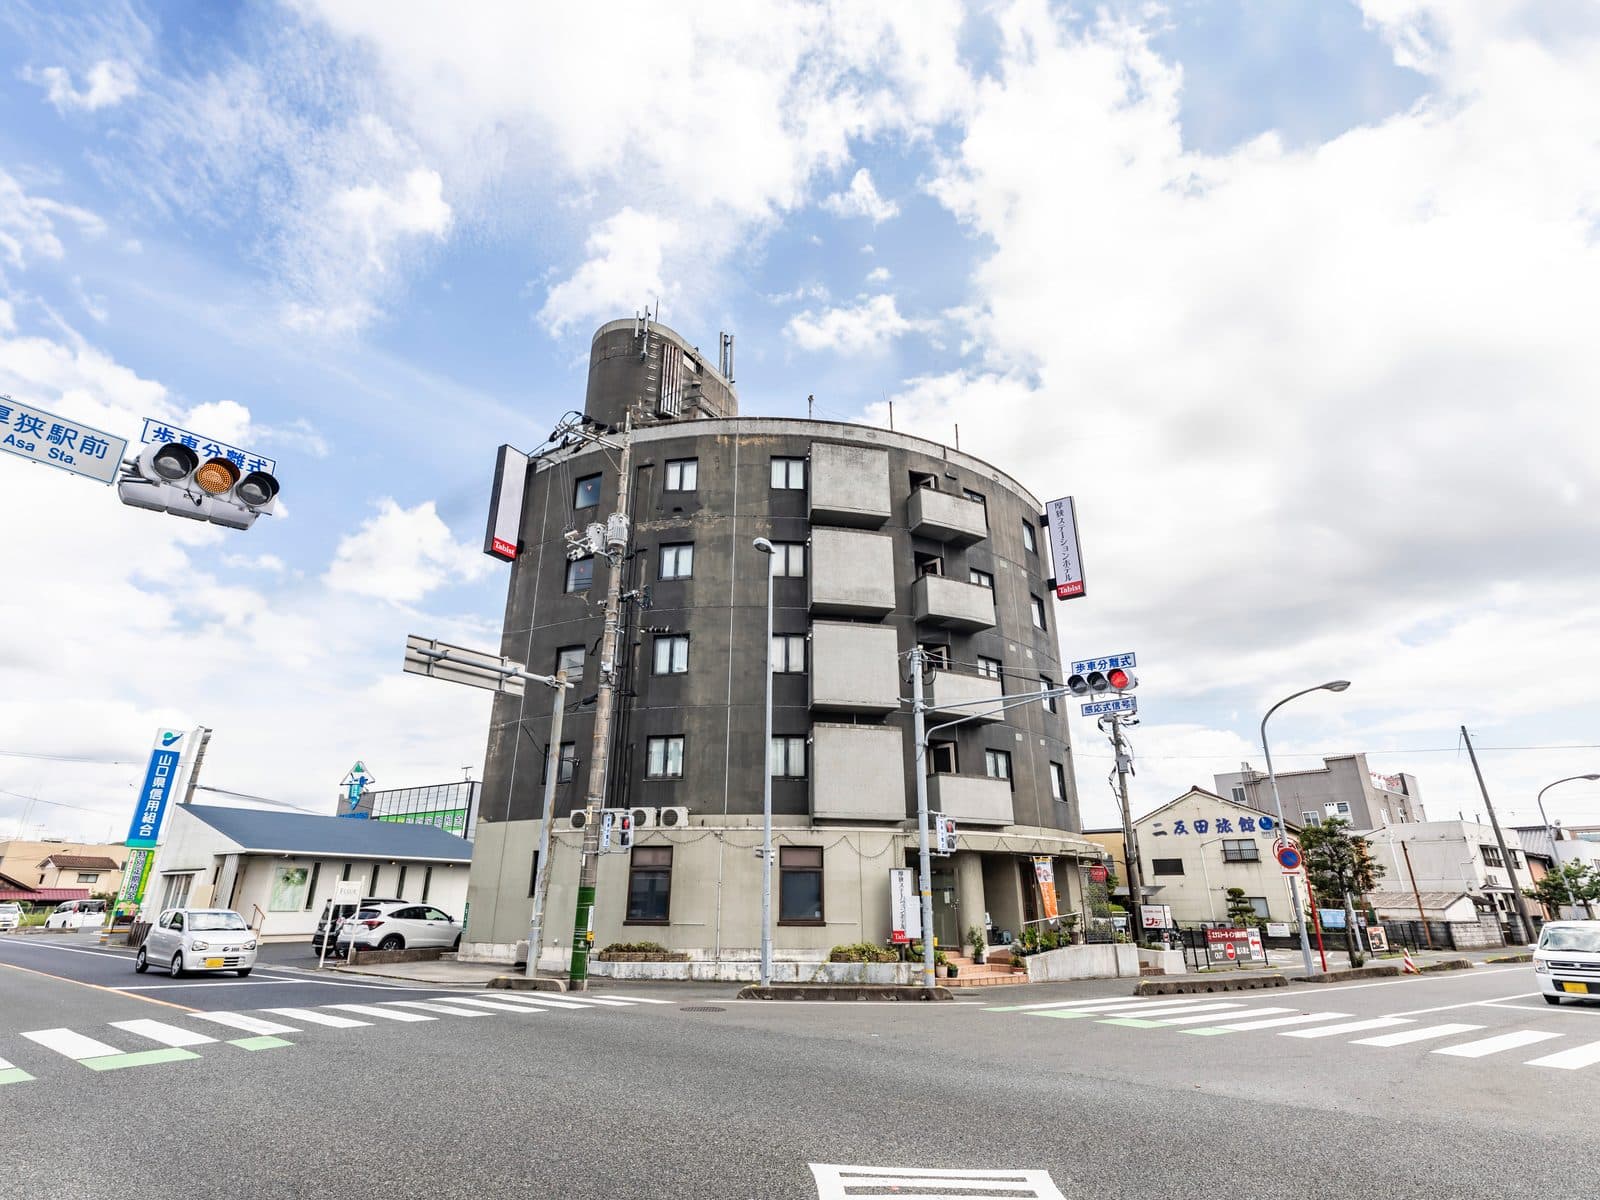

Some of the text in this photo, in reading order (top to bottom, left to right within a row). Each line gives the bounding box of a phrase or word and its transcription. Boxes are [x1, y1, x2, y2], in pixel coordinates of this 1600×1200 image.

[3, 433, 77, 466] Asa Sta.
[494, 540, 516, 556] Tabist
[1058, 584, 1081, 594] Tabist
[1075, 655, 1132, 674] 歩車分離式
[1084, 698, 1131, 714] 感応式信号
[139, 753, 173, 837] 山口県信用組合
